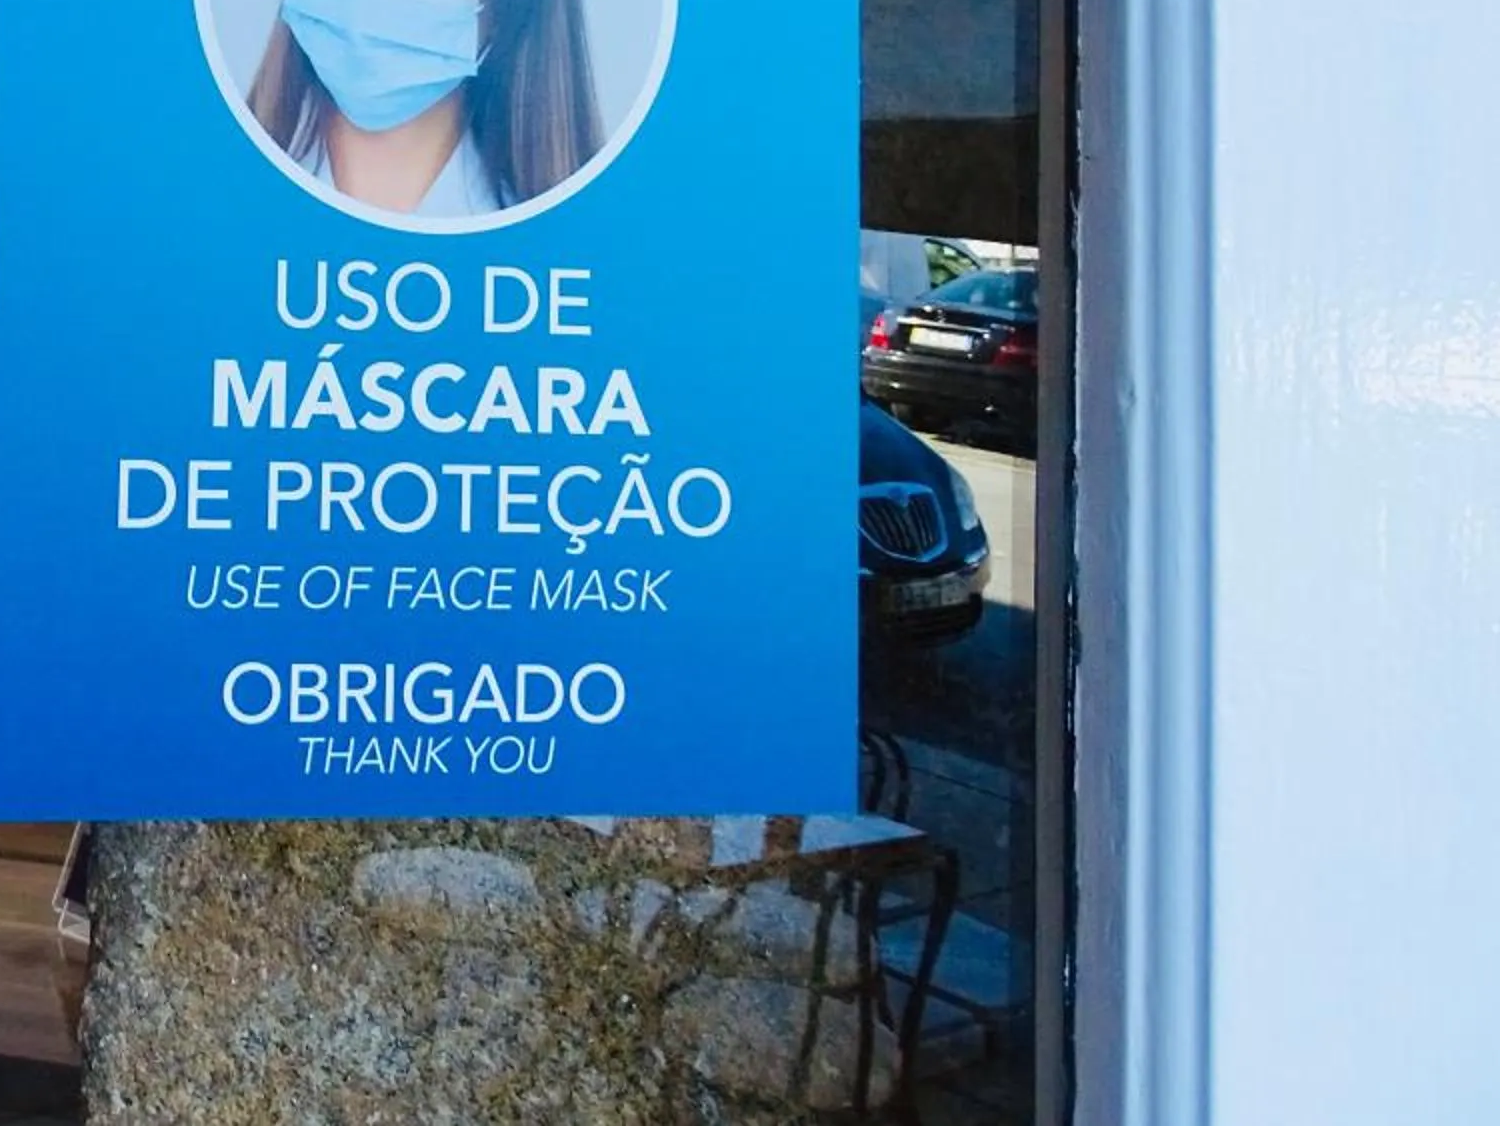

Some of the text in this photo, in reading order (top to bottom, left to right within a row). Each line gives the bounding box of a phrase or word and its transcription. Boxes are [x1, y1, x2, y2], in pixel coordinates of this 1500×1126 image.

[277, 260, 591, 335] USO DE
[213, 344, 650, 435] MÁSCARA
[118, 454, 731, 554] DE PROTEÇÃO
[188, 565, 670, 611] USE OF FACE MASK
[224, 662, 625, 724] OBRIGADO
[299, 736, 555, 773] THANK YOU
